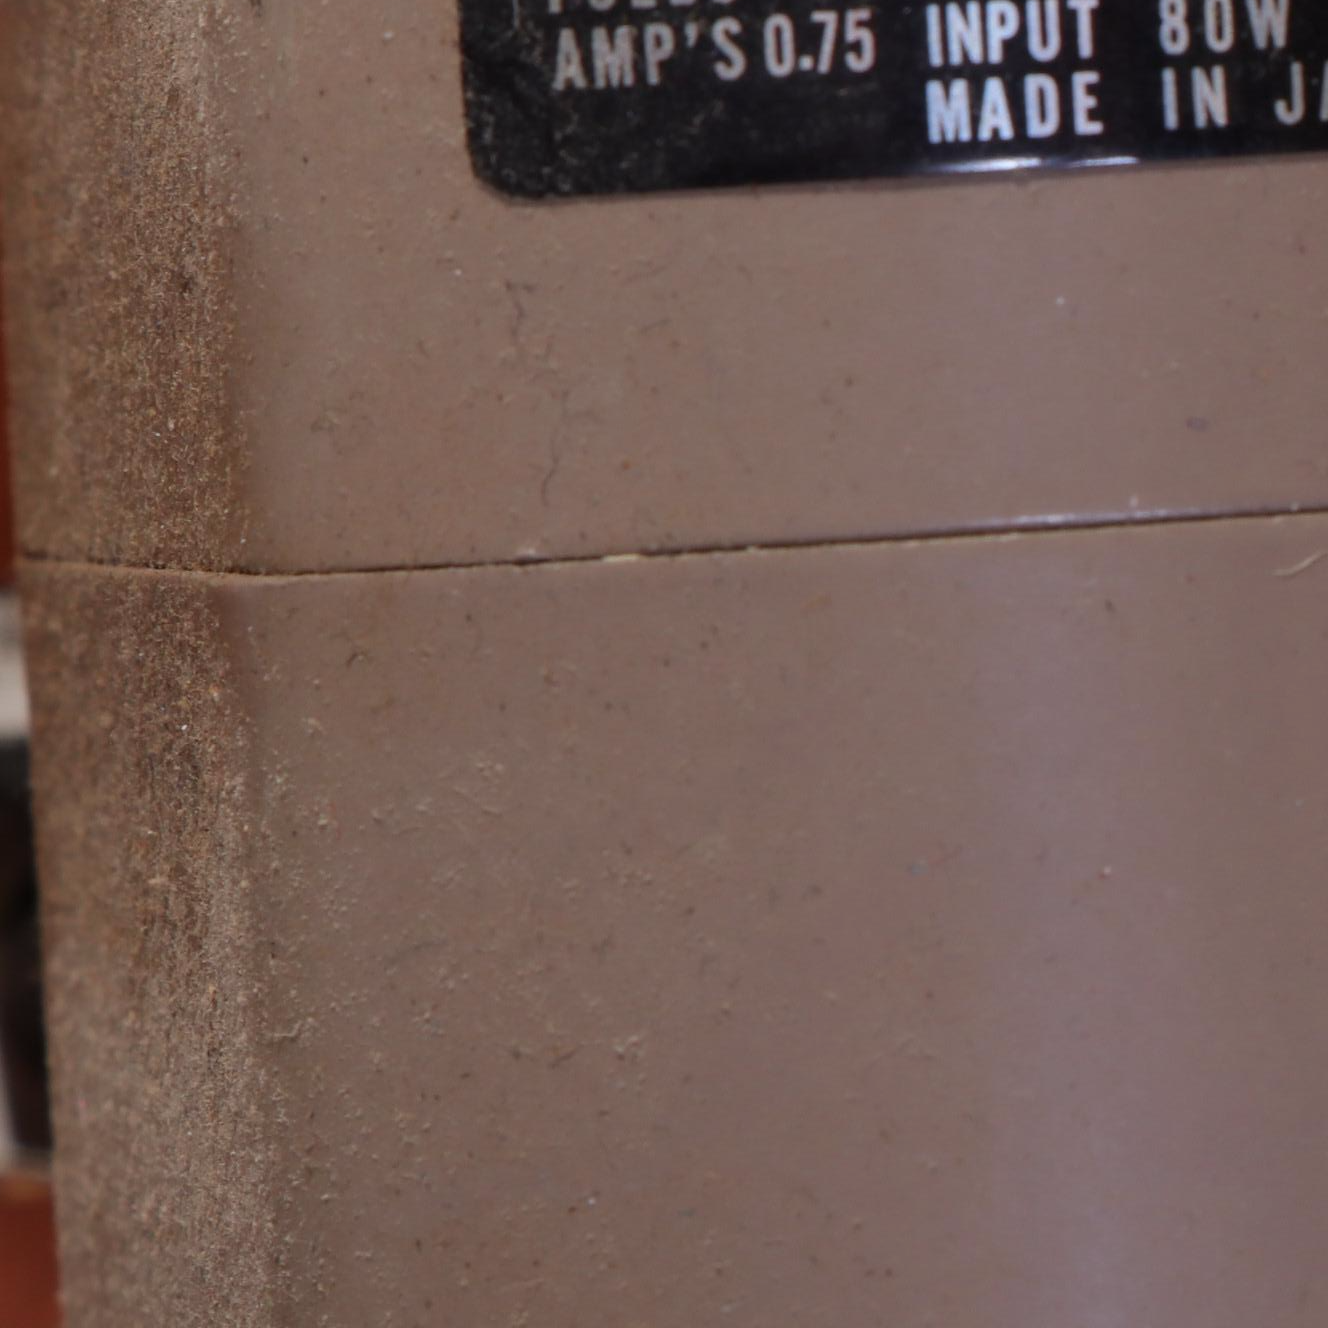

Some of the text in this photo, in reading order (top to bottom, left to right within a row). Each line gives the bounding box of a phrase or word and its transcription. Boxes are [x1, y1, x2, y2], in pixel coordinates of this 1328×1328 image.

[551, 7, 877, 91] AMP'S 0.75
[926, 70, 1104, 145] MADE
[1161, 63, 1228, 132] IN
